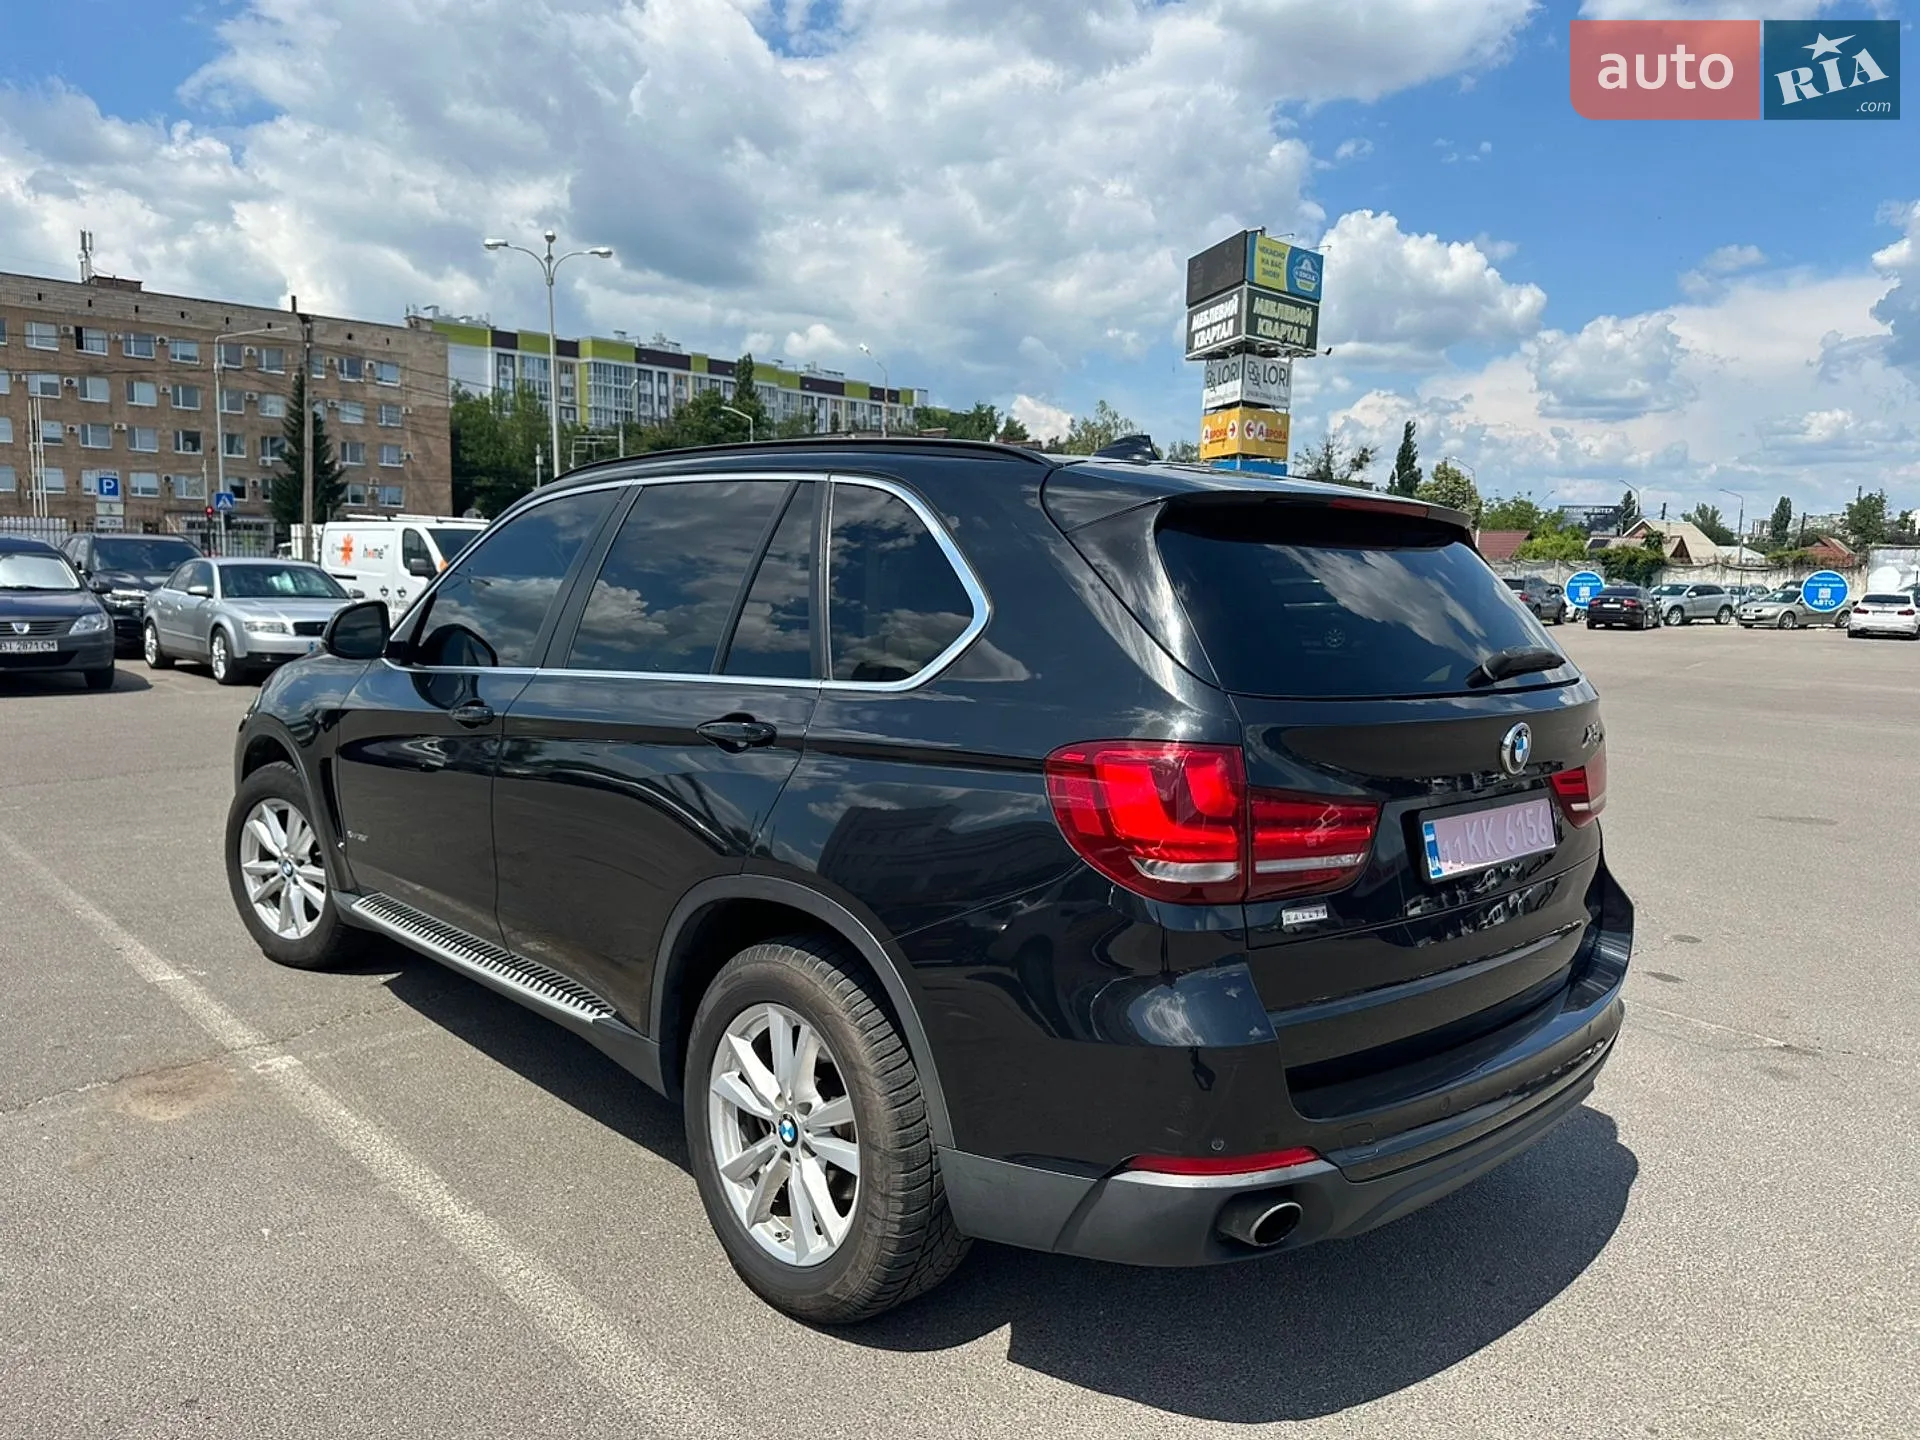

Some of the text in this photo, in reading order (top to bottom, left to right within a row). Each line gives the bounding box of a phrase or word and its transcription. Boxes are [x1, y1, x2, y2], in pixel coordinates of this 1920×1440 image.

[1191, 293, 1239, 332] МЕБЛЕВИЙ
[1194, 318, 1234, 349] КВАРТАЛ
[1257, 317, 1307, 345] КВАРТАЛ
[1217, 361, 1241, 386] LORI
[1262, 364, 1290, 388] LORI
[1505, 806, 1550, 853] 6156
